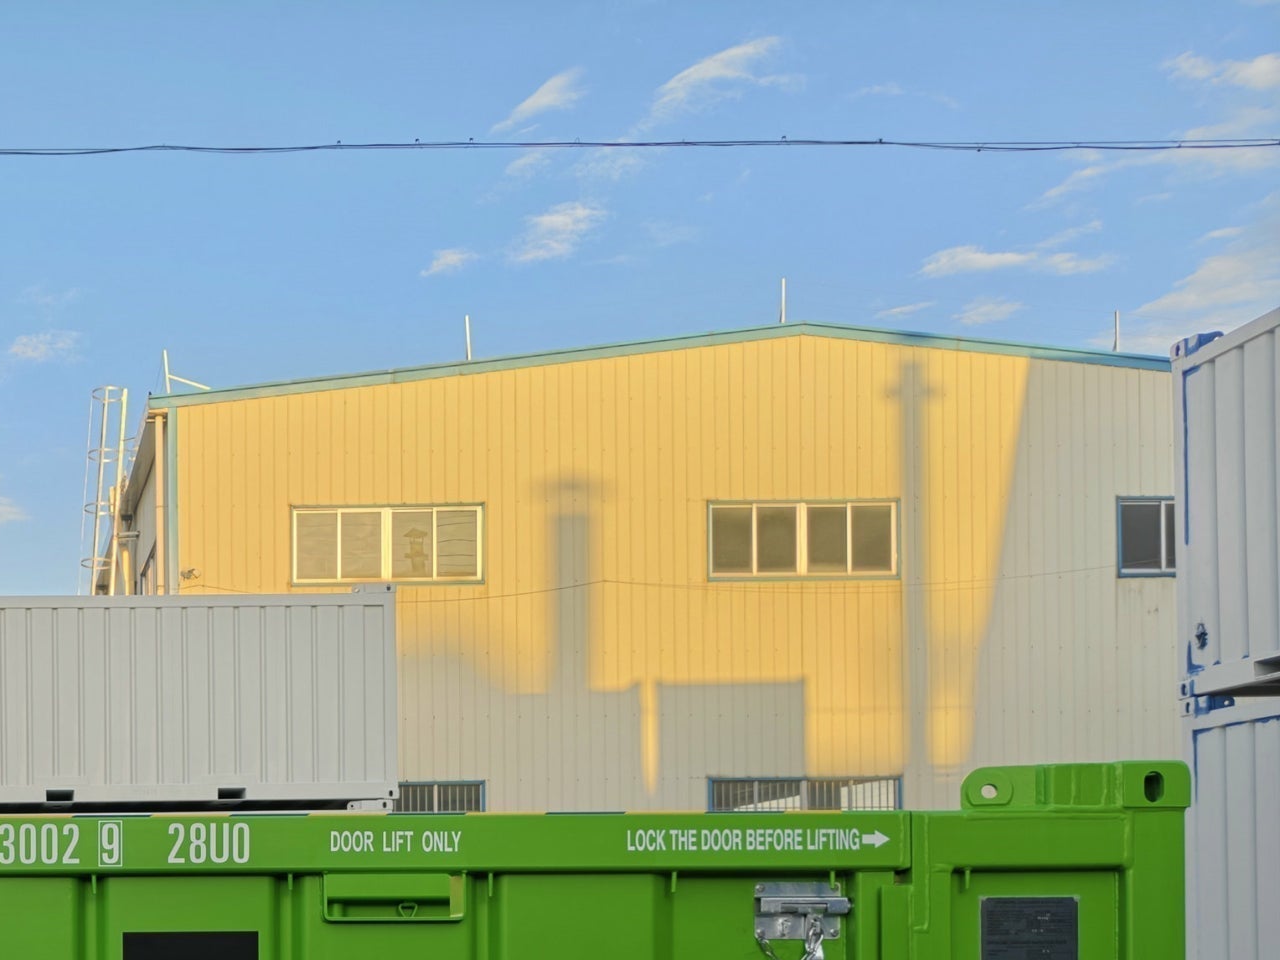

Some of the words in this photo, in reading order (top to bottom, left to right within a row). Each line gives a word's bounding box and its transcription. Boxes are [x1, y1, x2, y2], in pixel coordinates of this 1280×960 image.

[101, 823, 120, 864] 9
[167, 822, 250, 864] 28U0
[330, 830, 374, 852] DOOR
[382, 830, 414, 852] LIFT
[421, 830, 462, 853] ONLY
[627, 829, 666, 851] LOCK
[669, 829, 698, 851] THE
[701, 829, 742, 851] DOOR
[746, 828, 803, 851] BEFORE
[807, 828, 860, 850] LIFTING
